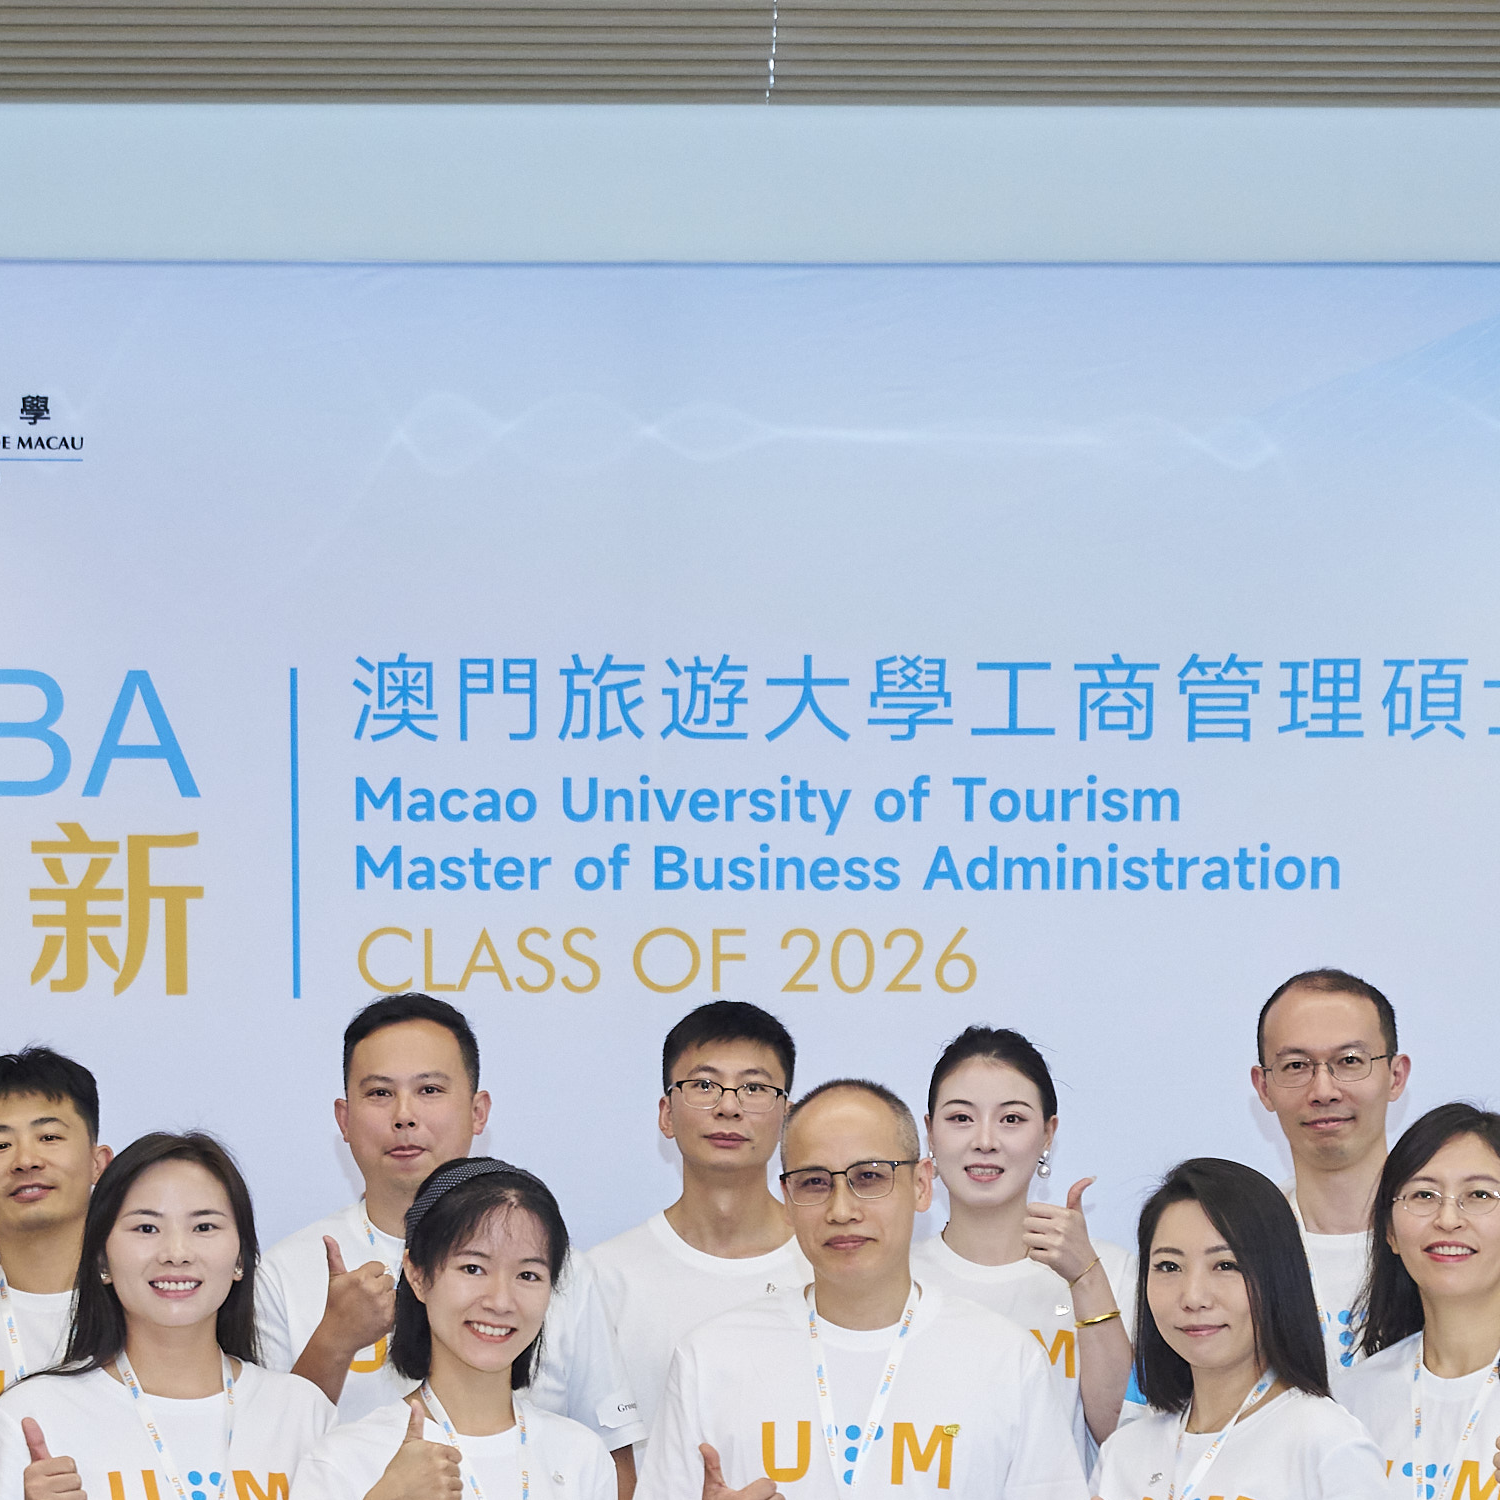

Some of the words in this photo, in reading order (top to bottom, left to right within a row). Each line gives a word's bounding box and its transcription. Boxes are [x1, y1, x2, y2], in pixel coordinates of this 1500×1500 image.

[18, 437, 83, 450] MACAU
[355, 777, 537, 822] Macao
[563, 774, 851, 836] University
[874, 775, 930, 822] of
[952, 774, 1180, 822] Tourism
[356, 845, 552, 891] Master
[575, 843, 630, 891] of
[654, 843, 900, 891] Business
[923, 843, 1340, 891] Administration
[358, 927, 601, 996] CLASS
[633, 927, 746, 993] OF
[781, 927, 977, 994] 2026
